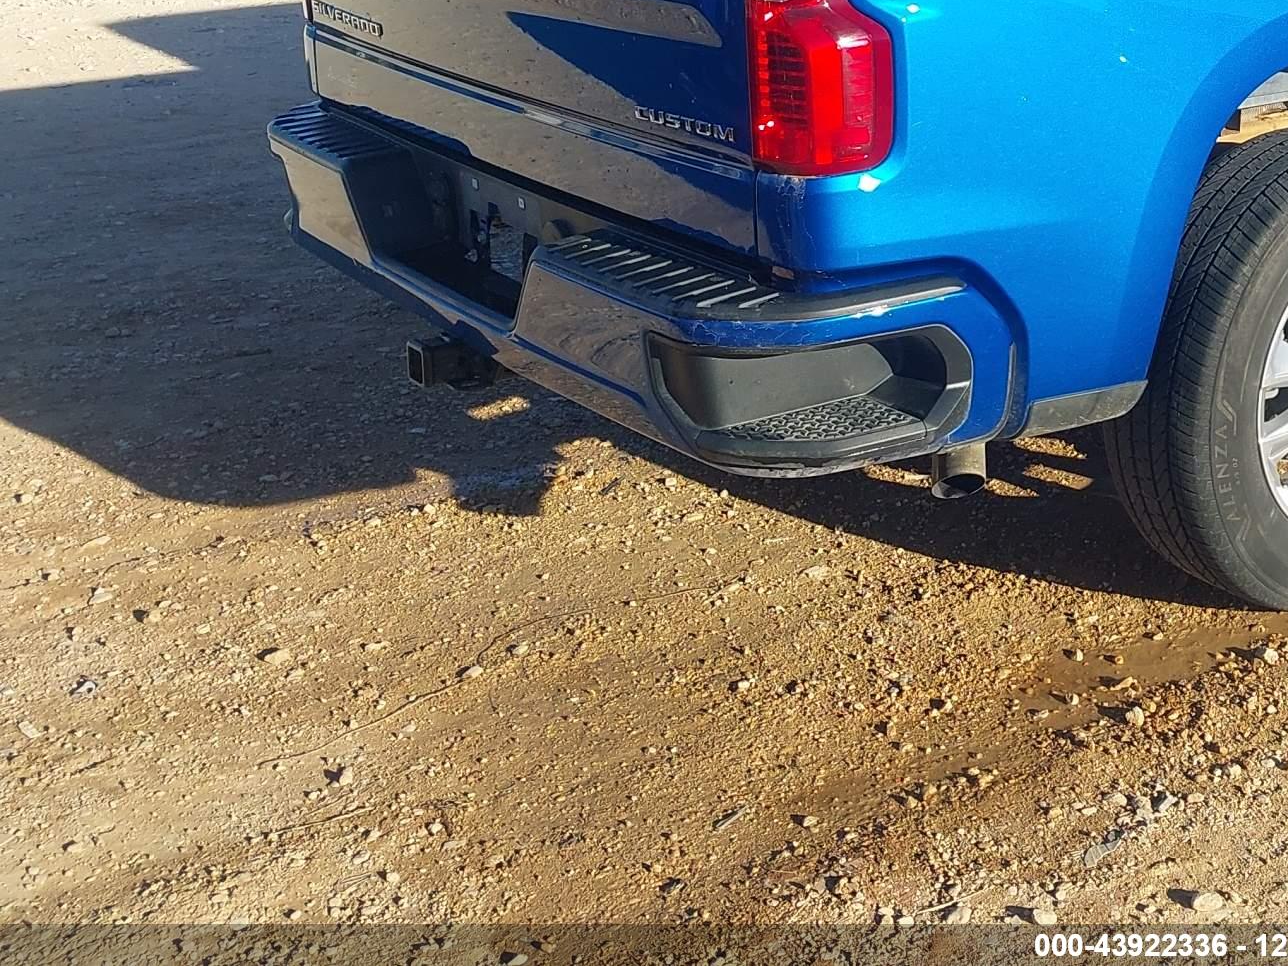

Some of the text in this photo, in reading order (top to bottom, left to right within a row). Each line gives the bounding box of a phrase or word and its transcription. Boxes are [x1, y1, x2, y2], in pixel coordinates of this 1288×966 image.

[312, 0, 384, 38] SILVERADO
[634, 105, 735, 142] CUSTOM
[1214, 424, 1241, 522] ALENZA
